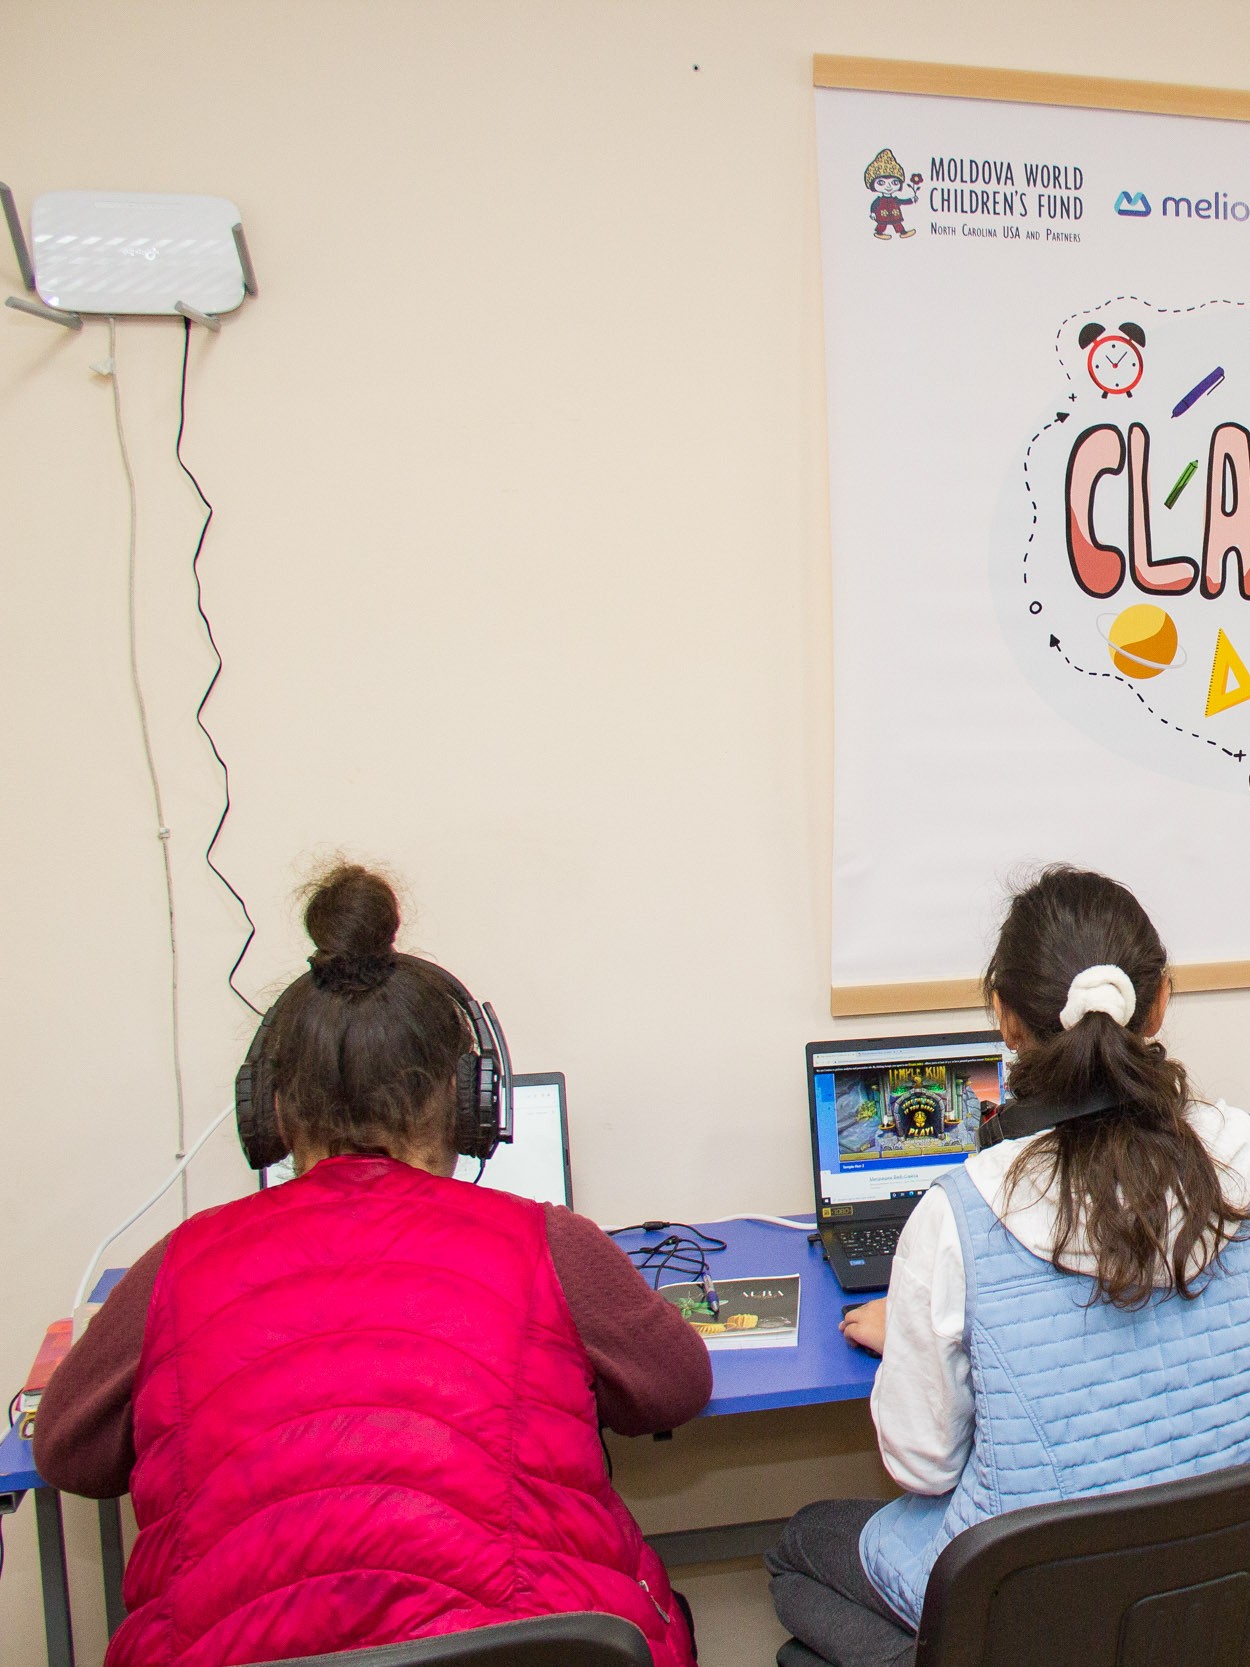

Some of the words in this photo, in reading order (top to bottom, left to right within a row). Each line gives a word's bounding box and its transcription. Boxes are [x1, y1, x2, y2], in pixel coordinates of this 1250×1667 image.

[930, 157, 1015, 186] MOLDOVA
[1024, 163, 1084, 191] WORLD
[929, 187, 1028, 218] CHILDREN'S
[1038, 193, 1084, 221] FUND
[1003, 226, 1021, 240] USA
[908, 1126, 934, 1137] PLAY!
